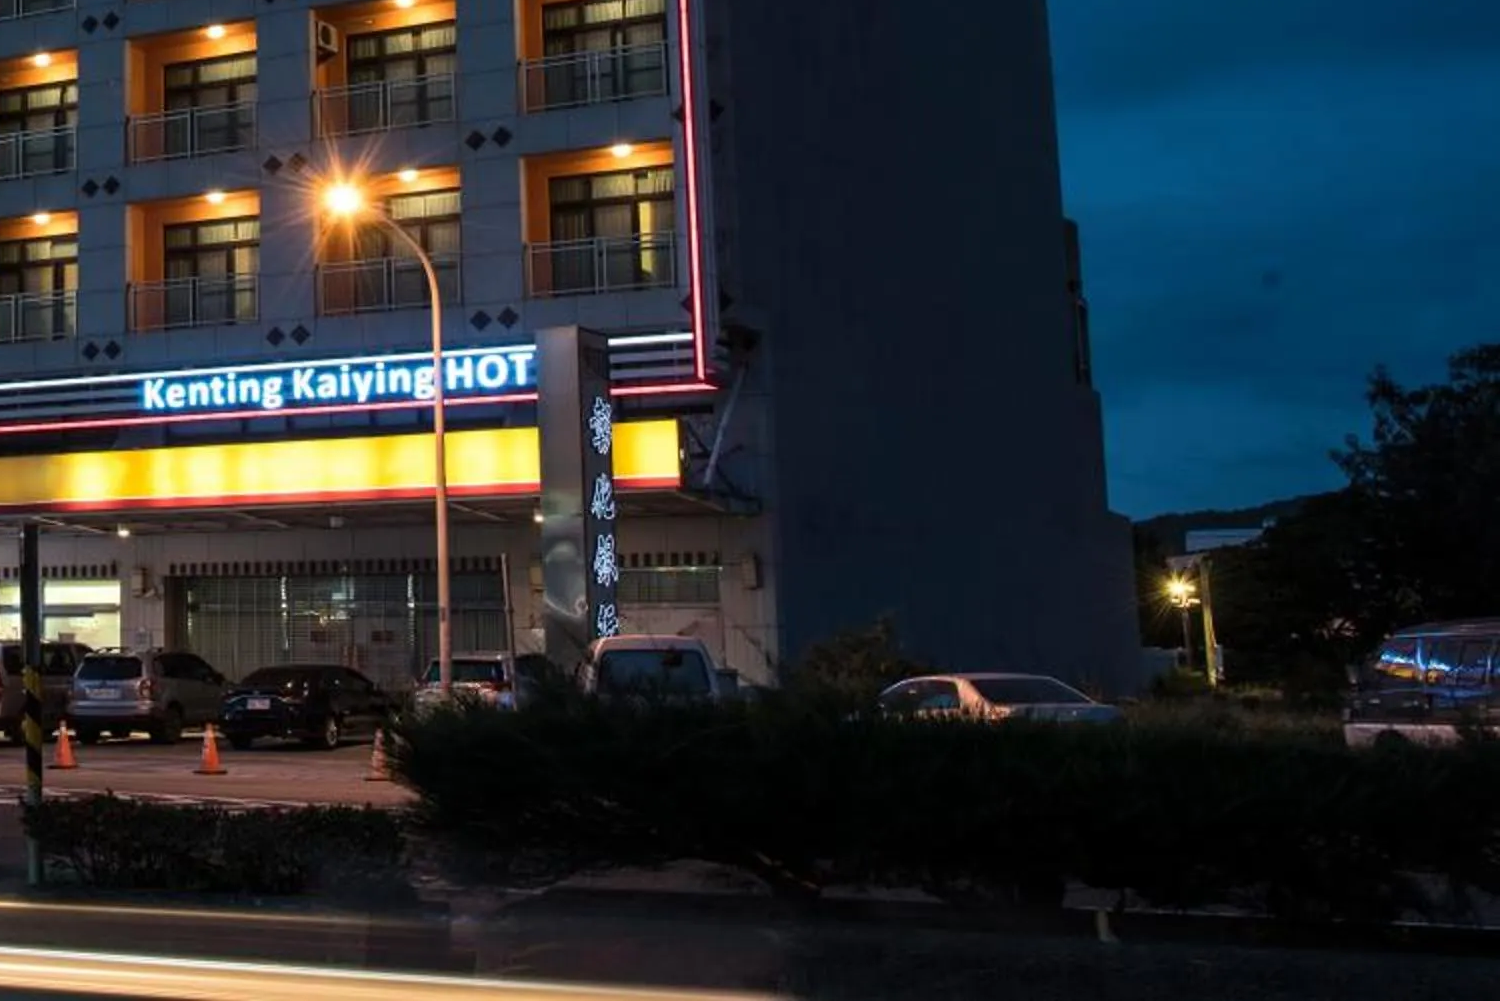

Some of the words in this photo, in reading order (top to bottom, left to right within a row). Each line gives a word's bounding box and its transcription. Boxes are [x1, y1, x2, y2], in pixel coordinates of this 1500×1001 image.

[143, 372, 283, 409] Kenting
[293, 362, 437, 403] Kaiying
[446, 352, 533, 389] HOT
